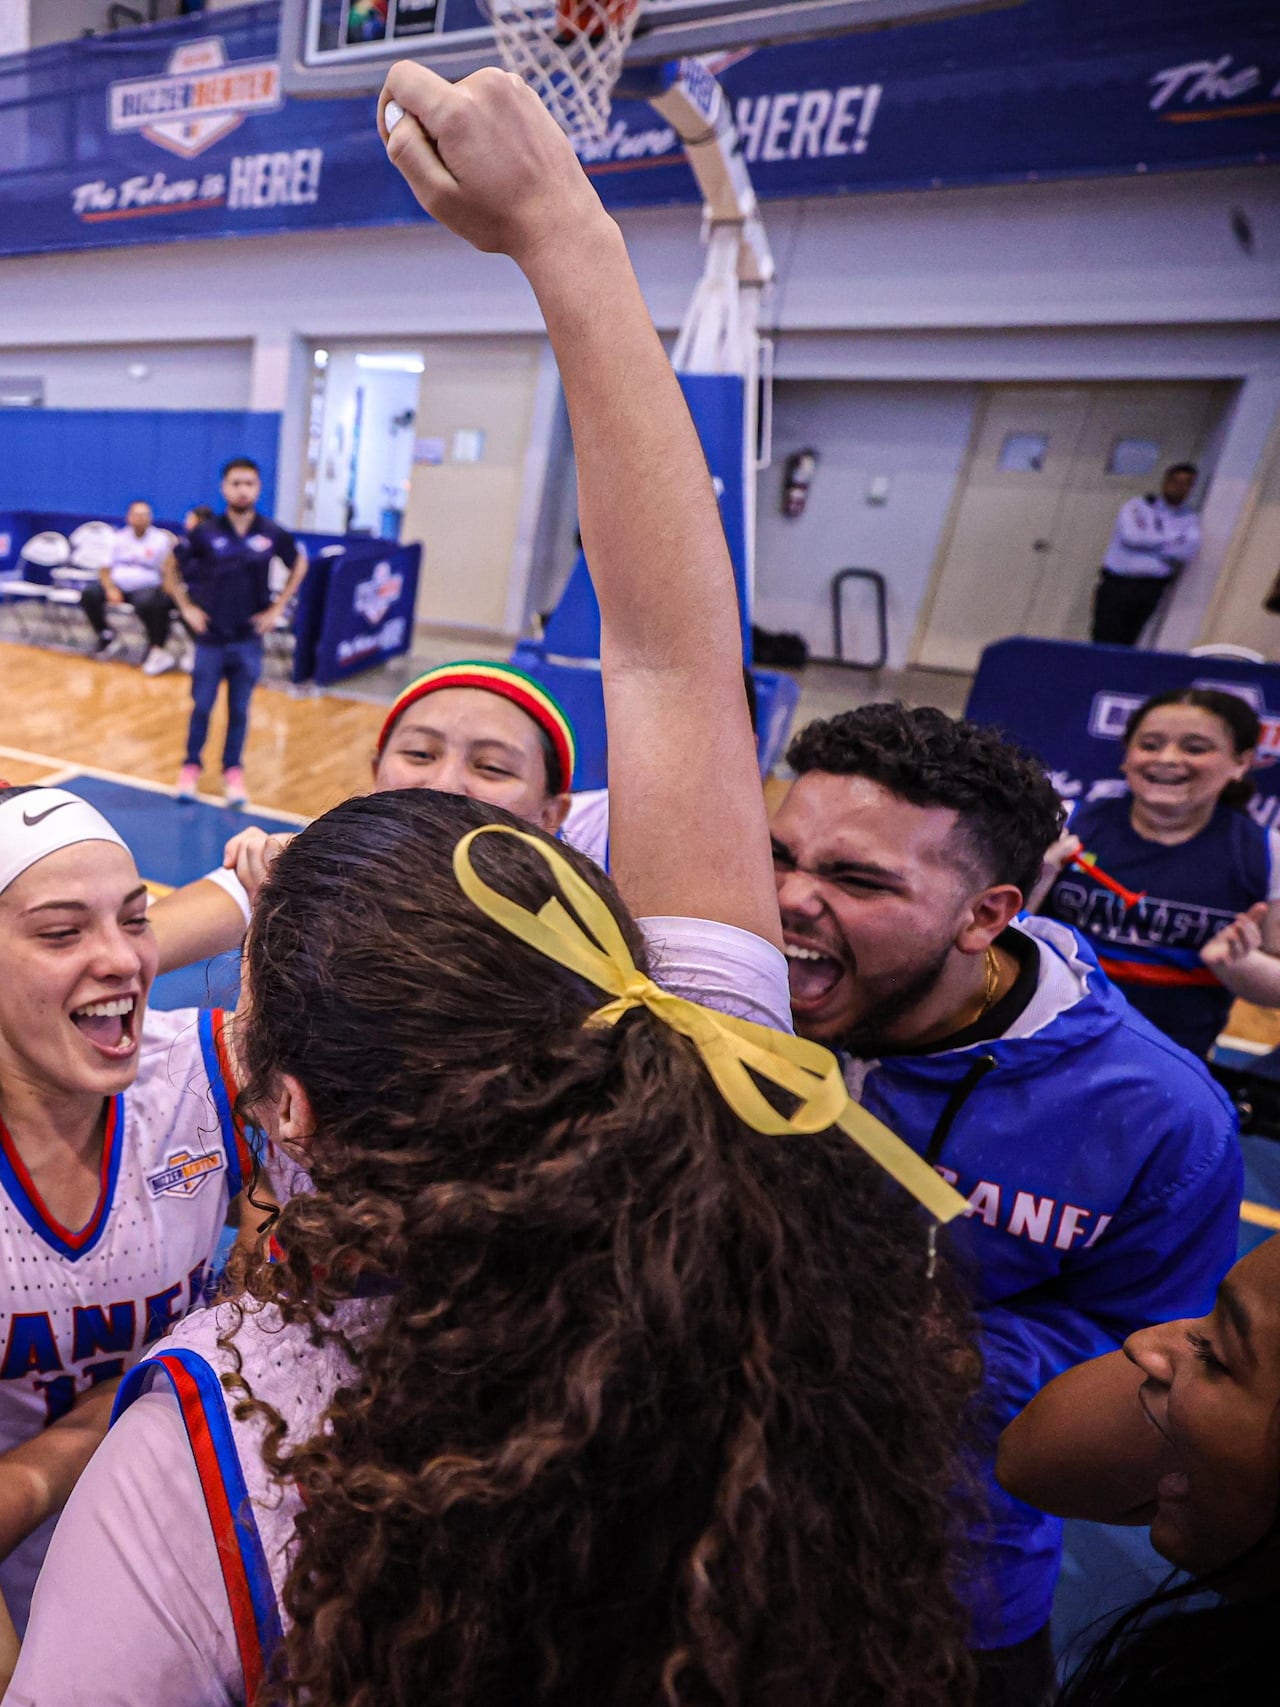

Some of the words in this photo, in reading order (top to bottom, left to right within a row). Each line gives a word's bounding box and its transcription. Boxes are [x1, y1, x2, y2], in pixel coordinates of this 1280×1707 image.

[1149, 55, 1260, 110] The
[735, 83, 882, 162] HERE!
[73, 180, 117, 215] The
[118, 171, 199, 209] Future
[227, 148, 323, 210] HERE!
